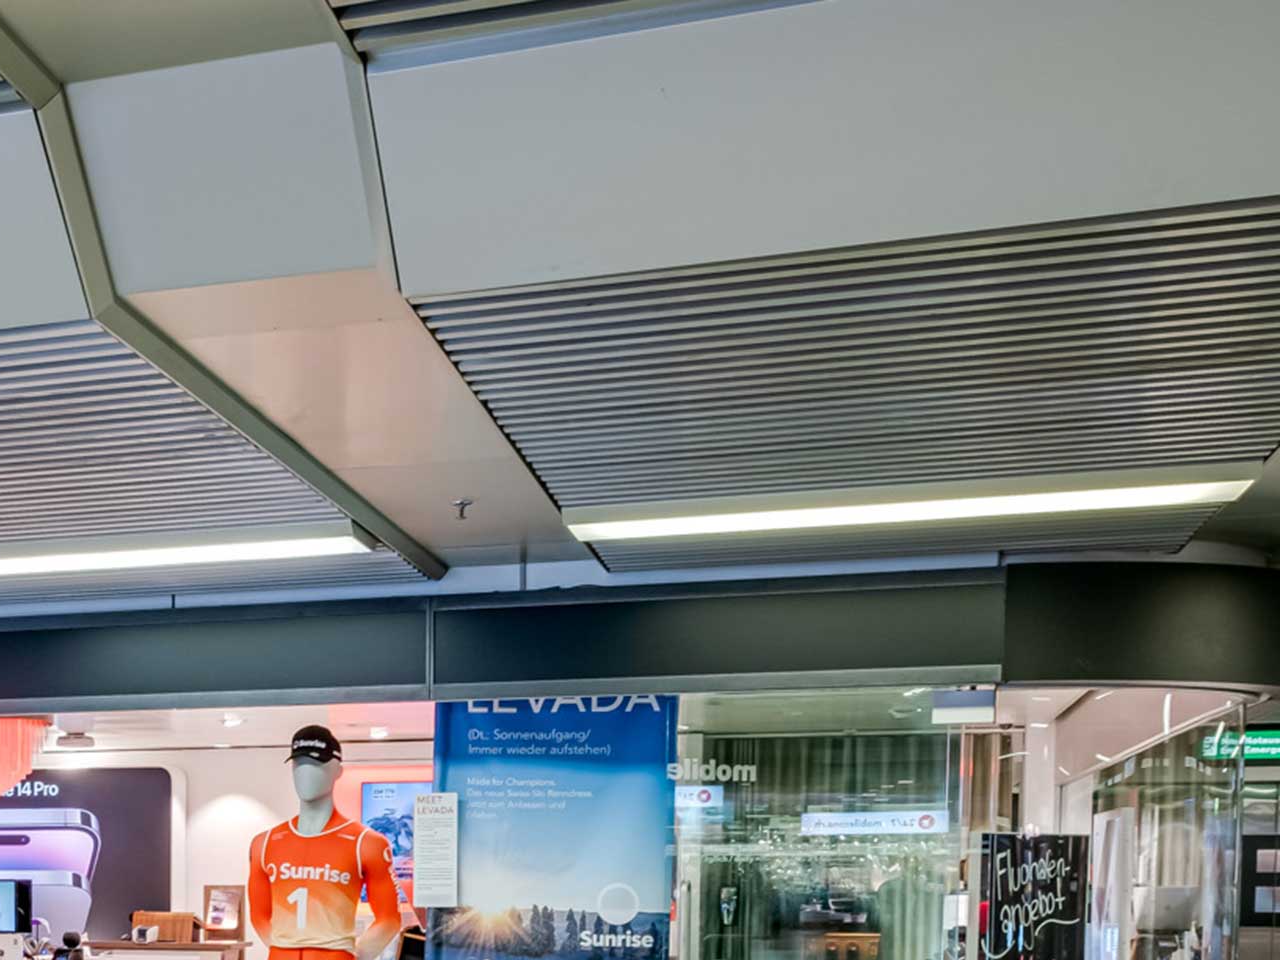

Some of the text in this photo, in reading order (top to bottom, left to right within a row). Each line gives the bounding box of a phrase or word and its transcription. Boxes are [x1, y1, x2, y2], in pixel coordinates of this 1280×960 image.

[468, 743, 612, 756] Immer wieder aufstehen)
[16, 781, 32, 797] 14
[33, 781, 60, 796] Pro
[417, 795, 443, 804] MEET
[417, 805, 455, 815] LEVADA
[279, 862, 351, 885] Sunrise
[287, 887, 308, 930] 1
[1000, 876, 1067, 950] angebot
[579, 929, 654, 949] Sunrise
